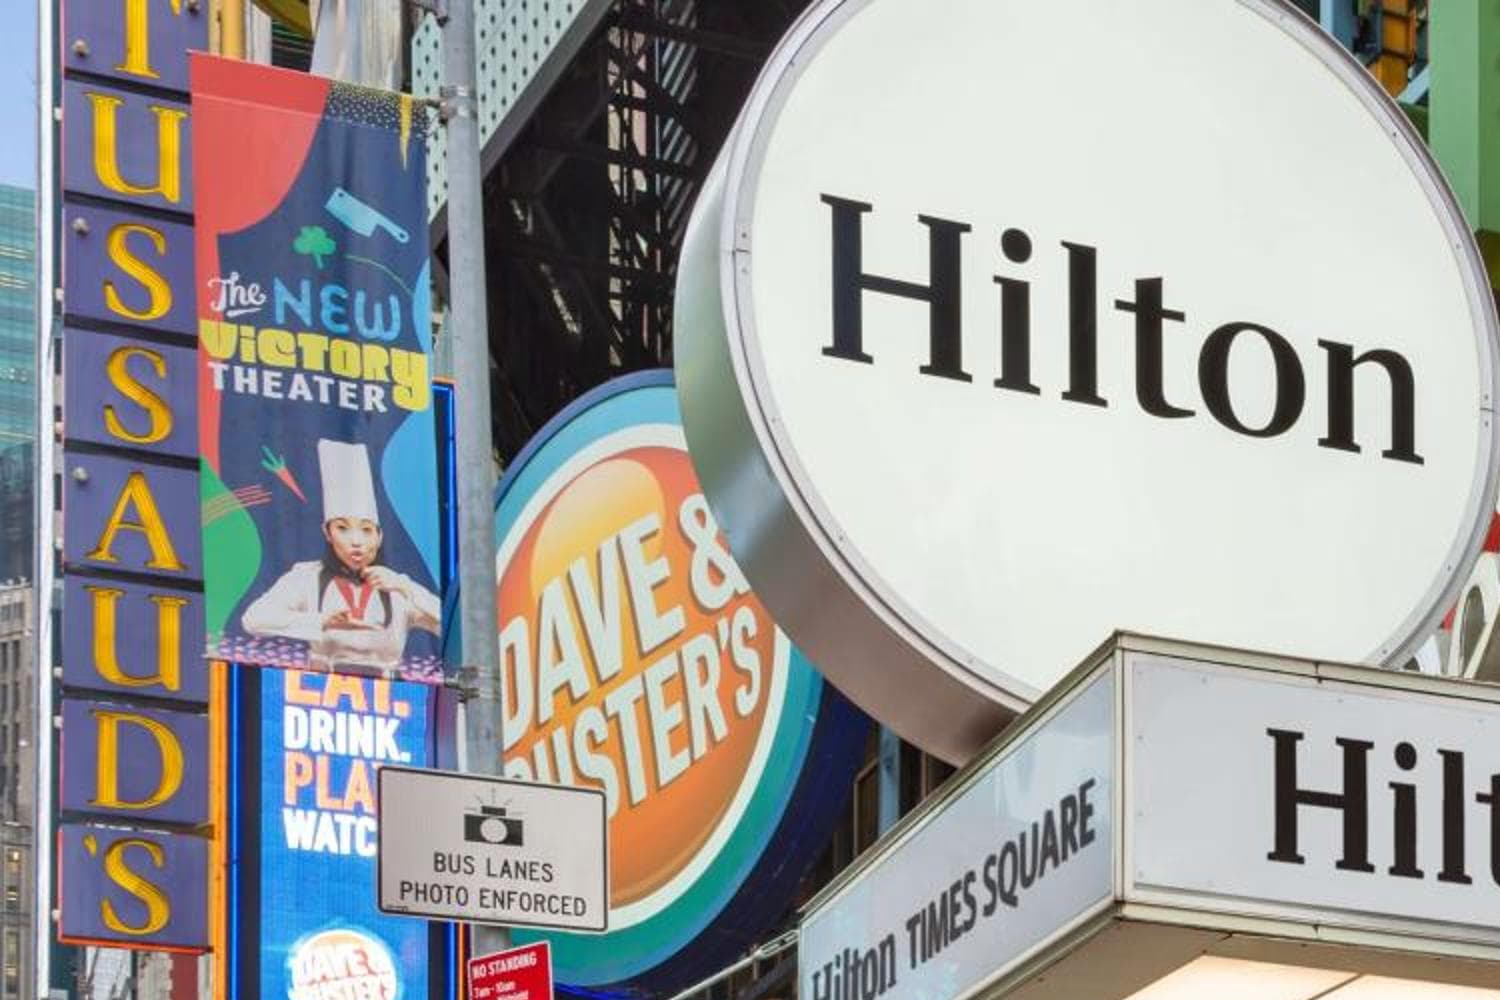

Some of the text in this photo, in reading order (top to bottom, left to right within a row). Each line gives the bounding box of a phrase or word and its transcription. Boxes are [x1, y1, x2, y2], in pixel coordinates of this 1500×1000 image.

[208, 272, 400, 342] The NEW
[820, 192, 1425, 466] Hilton
[208, 361, 388, 413] THEATER
[500, 512, 685, 752] DAVE
[283, 705, 412, 763] DRINK.
[284, 753, 382, 814] PLA
[433, 851, 554, 884] BUS LANES
[905, 869, 977, 971] TIMES
[982, 777, 1098, 919] SQUARE
[400, 881, 588, 917] PHOTO ENFORCED
[472, 951, 538, 979] NO STANDING
